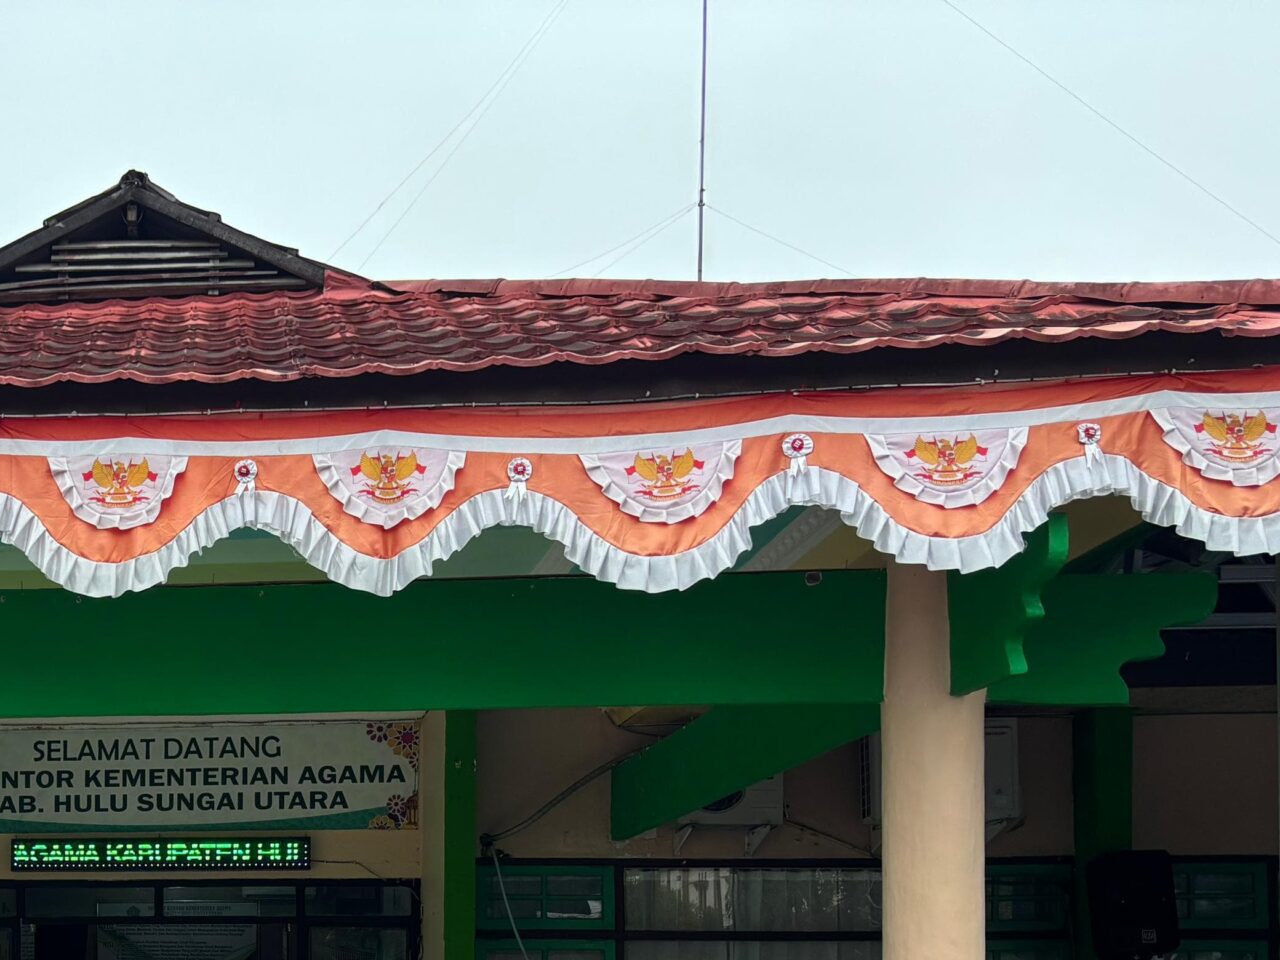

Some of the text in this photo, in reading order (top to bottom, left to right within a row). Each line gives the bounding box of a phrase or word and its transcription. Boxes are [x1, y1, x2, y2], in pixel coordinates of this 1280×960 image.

[33, 736, 281, 762] SELAMAT DATANG
[85, 766, 288, 788] KEMENTERIAN
[298, 764, 406, 784] AGAMA
[54, 794, 127, 813] HULU
[137, 791, 243, 812] SUNGAI
[254, 790, 349, 810] UTARA
[16, 844, 99, 861] AGAMA
